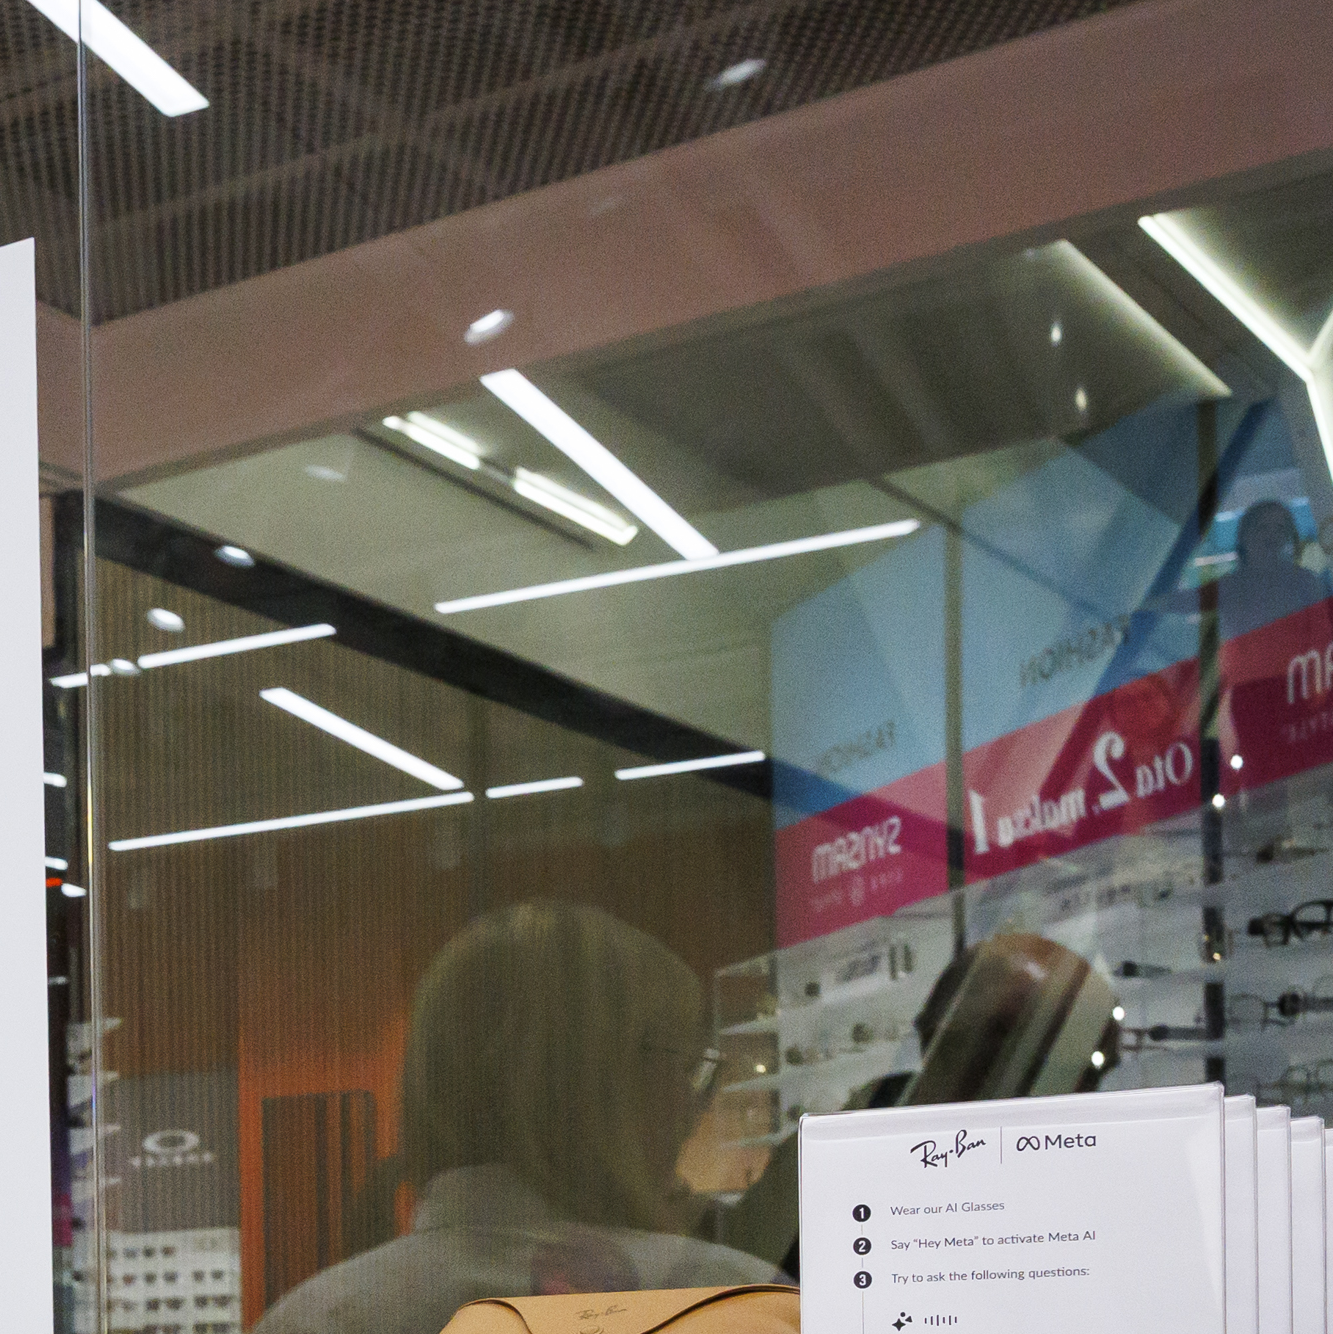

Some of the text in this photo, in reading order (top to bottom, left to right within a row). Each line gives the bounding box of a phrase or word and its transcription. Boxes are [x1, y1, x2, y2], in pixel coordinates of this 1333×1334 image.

[1044, 1133, 1097, 1151] Meta
[856, 1205, 868, 1220] 1
[889, 1201, 1005, 1216] Wear our AI Glasses
[856, 1238, 868, 1253] 2
[890, 1239, 911, 1252] Say
[981, 1236, 995, 1246] to
[997, 1233, 1045, 1245] activate
[1048, 1231, 1080, 1243] Meta
[1082, 1230, 1096, 1241] AI
[856, 1272, 868, 1287] 3
[891, 1266, 1090, 1286] Try to ask the following questions:
